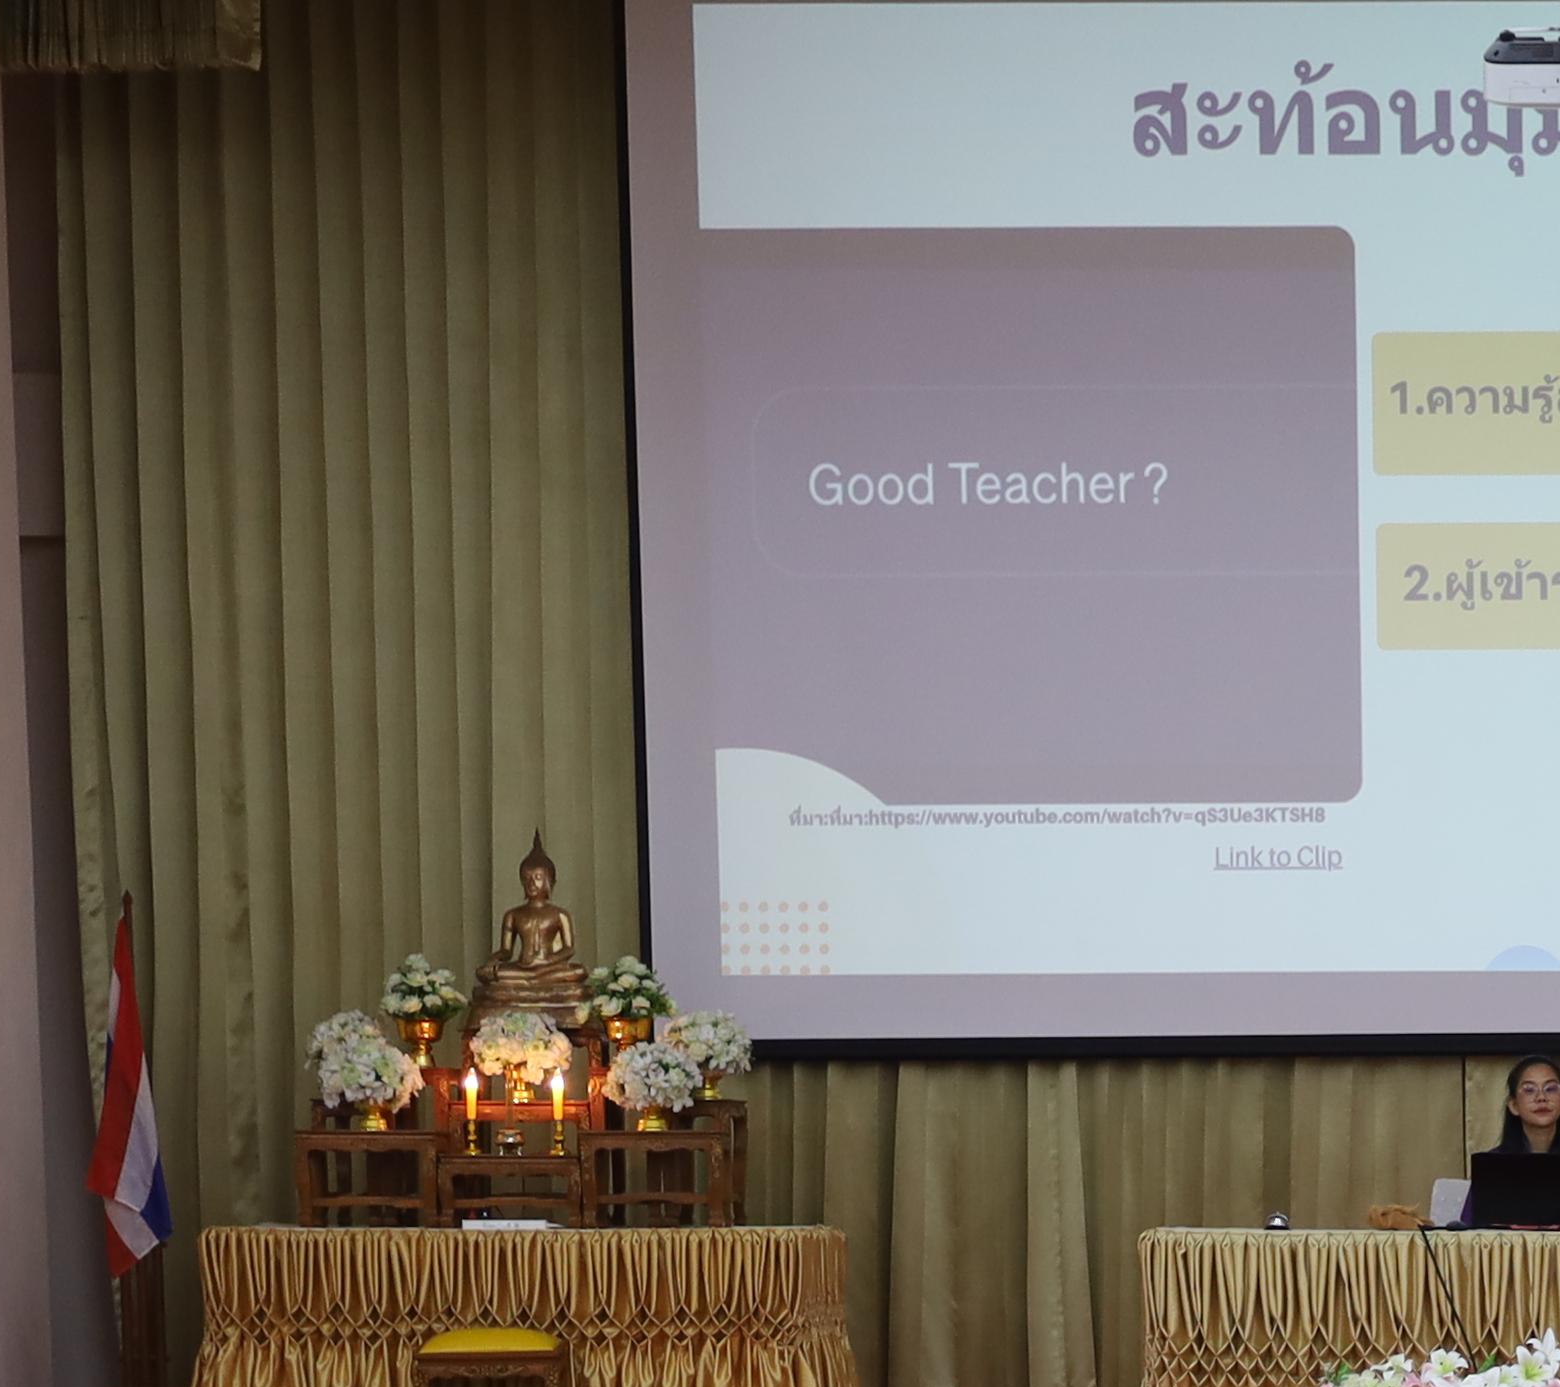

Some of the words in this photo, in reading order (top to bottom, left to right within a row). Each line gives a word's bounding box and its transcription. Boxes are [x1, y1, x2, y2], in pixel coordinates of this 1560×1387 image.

[808, 462, 935, 506] Good
[1214, 845, 1264, 871] Link
[1268, 847, 1292, 870] to
[1296, 844, 1344, 872] Clip
